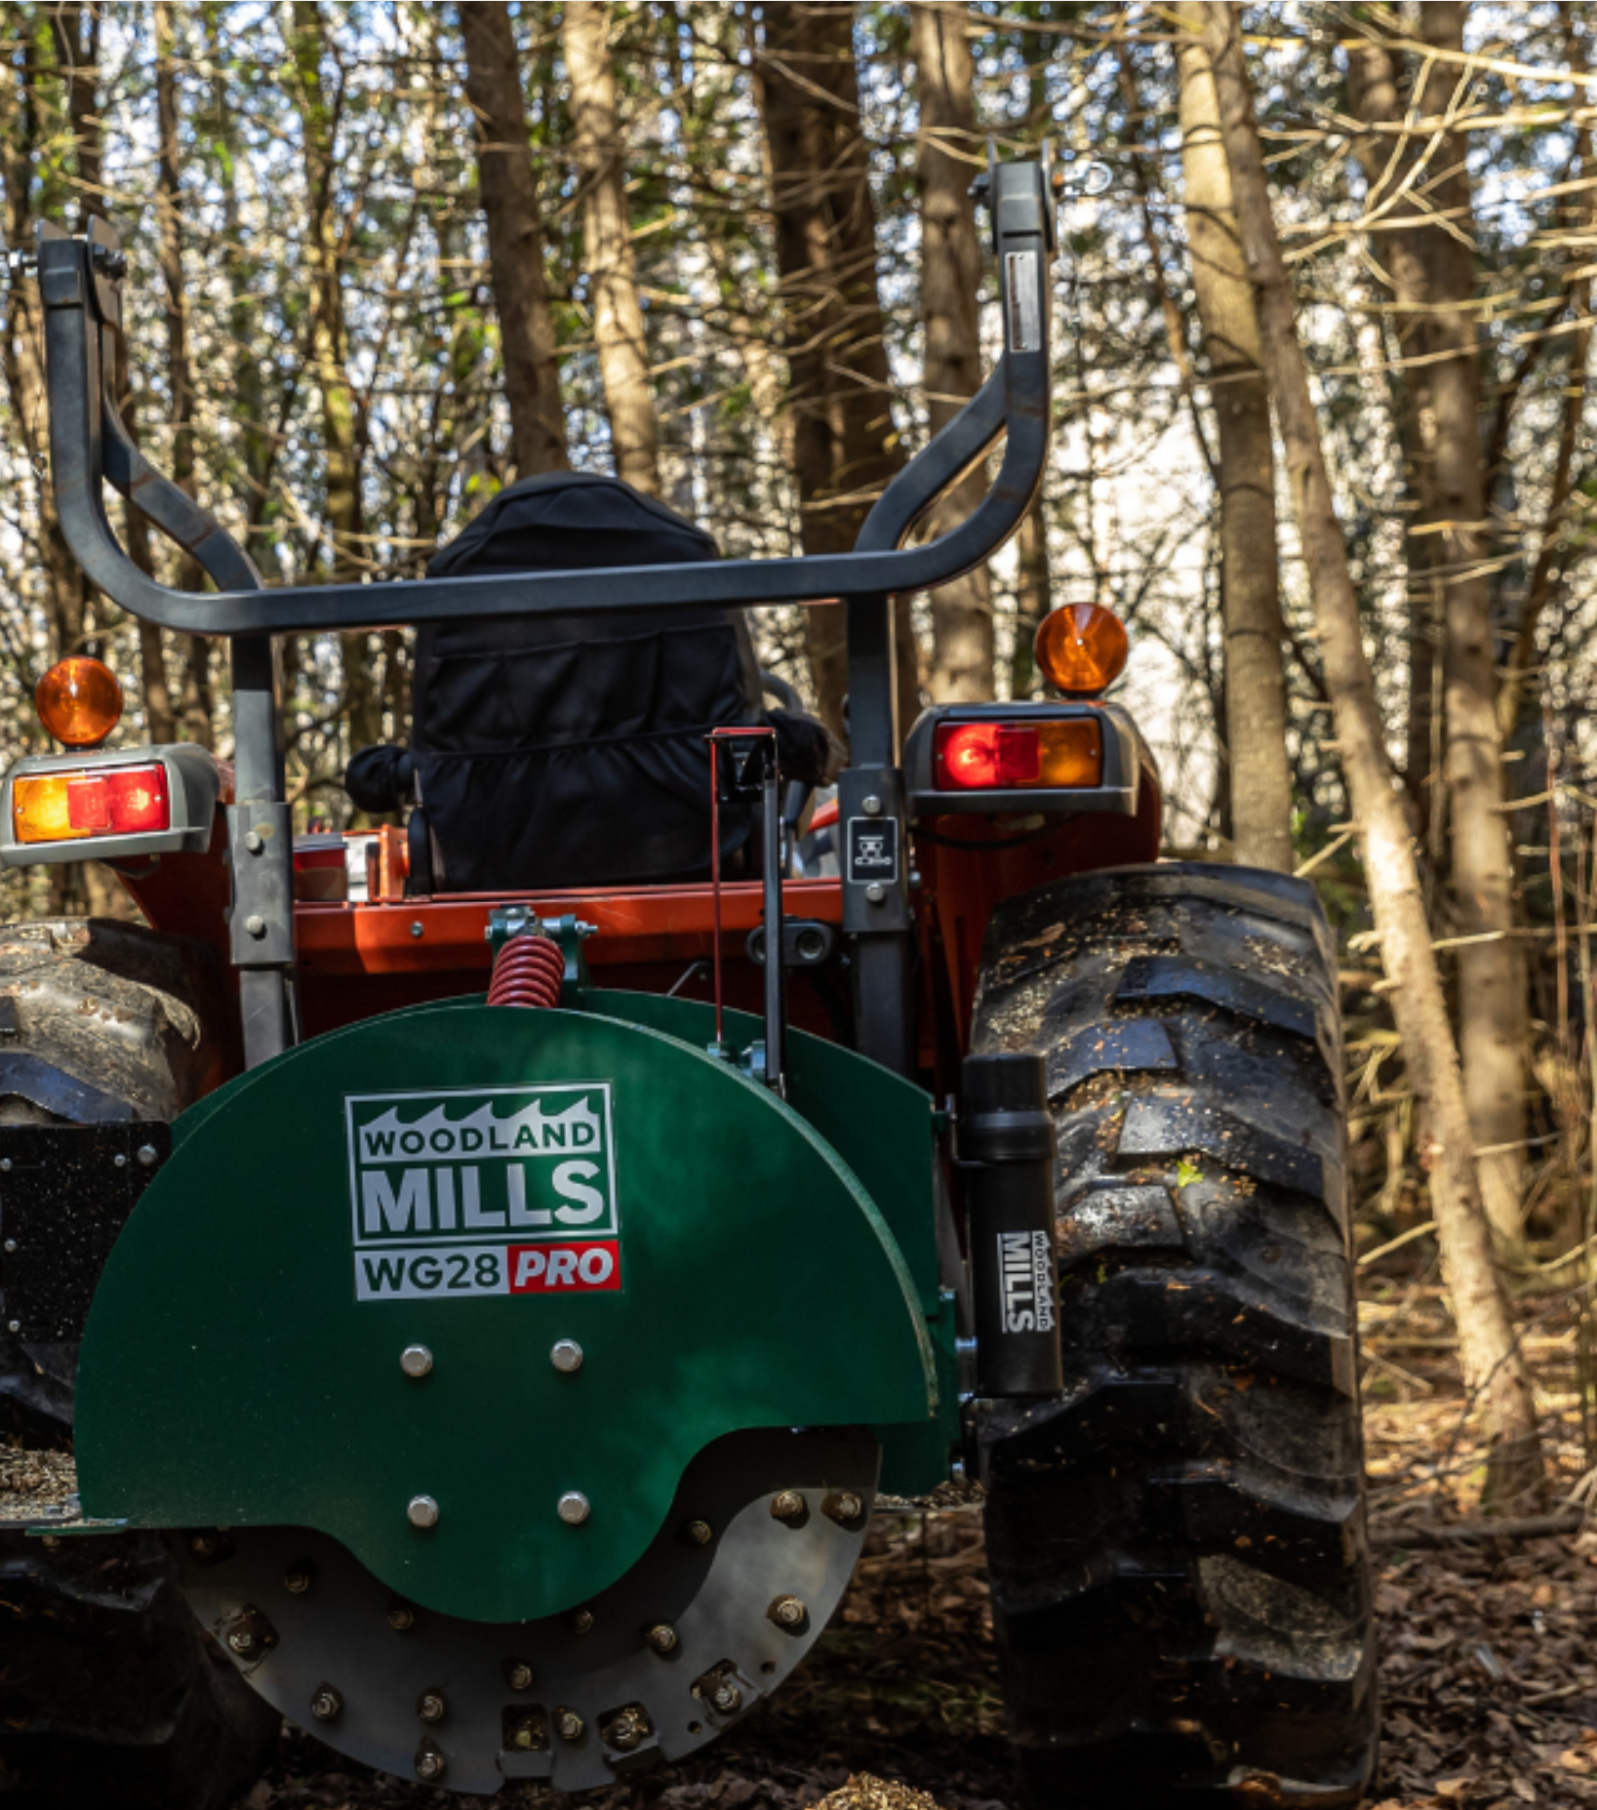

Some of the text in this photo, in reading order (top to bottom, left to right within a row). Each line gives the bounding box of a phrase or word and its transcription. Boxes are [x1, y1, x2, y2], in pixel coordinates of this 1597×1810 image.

[364, 1121, 596, 1157] WOODLAND
[361, 1159, 604, 1233] MILLS
[362, 1247, 614, 1293] WG28 PRO
[1002, 1231, 1034, 1333] MILLS
[1034, 1232, 1049, 1330] WOODLAND
